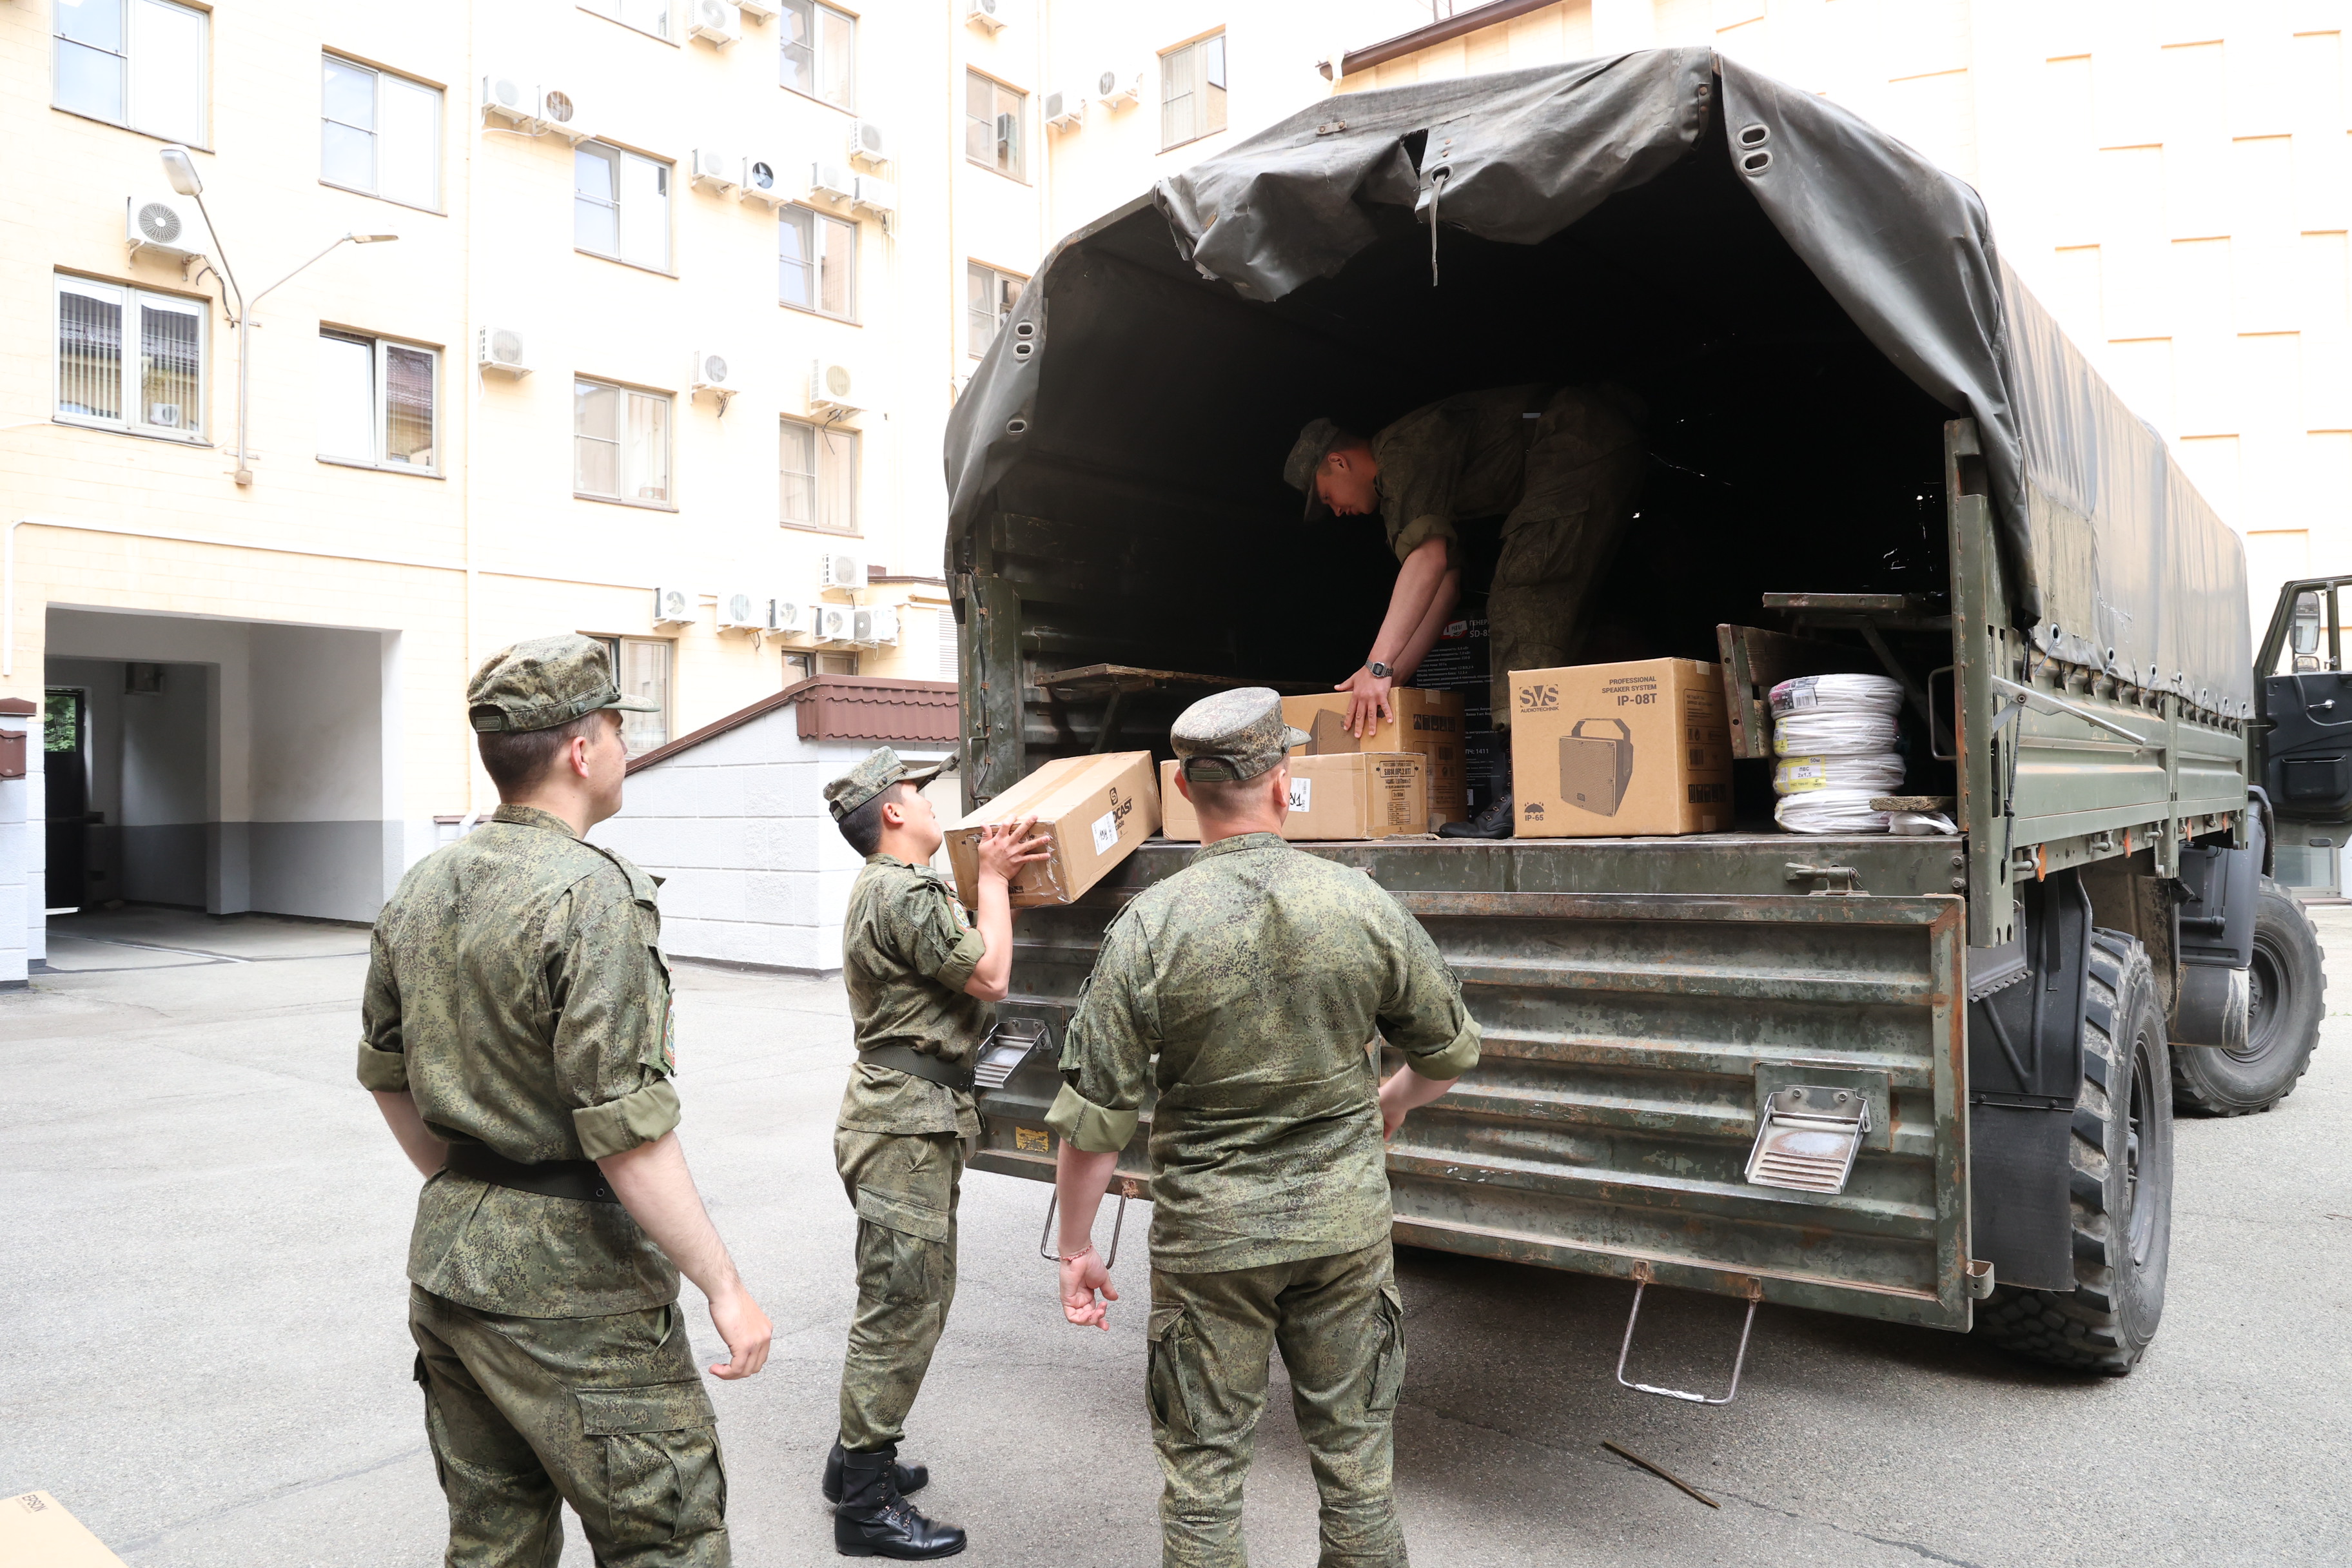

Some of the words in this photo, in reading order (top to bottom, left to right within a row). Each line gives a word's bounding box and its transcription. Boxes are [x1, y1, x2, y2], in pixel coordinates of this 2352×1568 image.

[1609, 676, 1656, 685] PROFESSIONAL
[1519, 683, 1559, 707] SVS
[1618, 693, 1657, 706] IP-08T
[22, 1494, 49, 1513] EPSON
